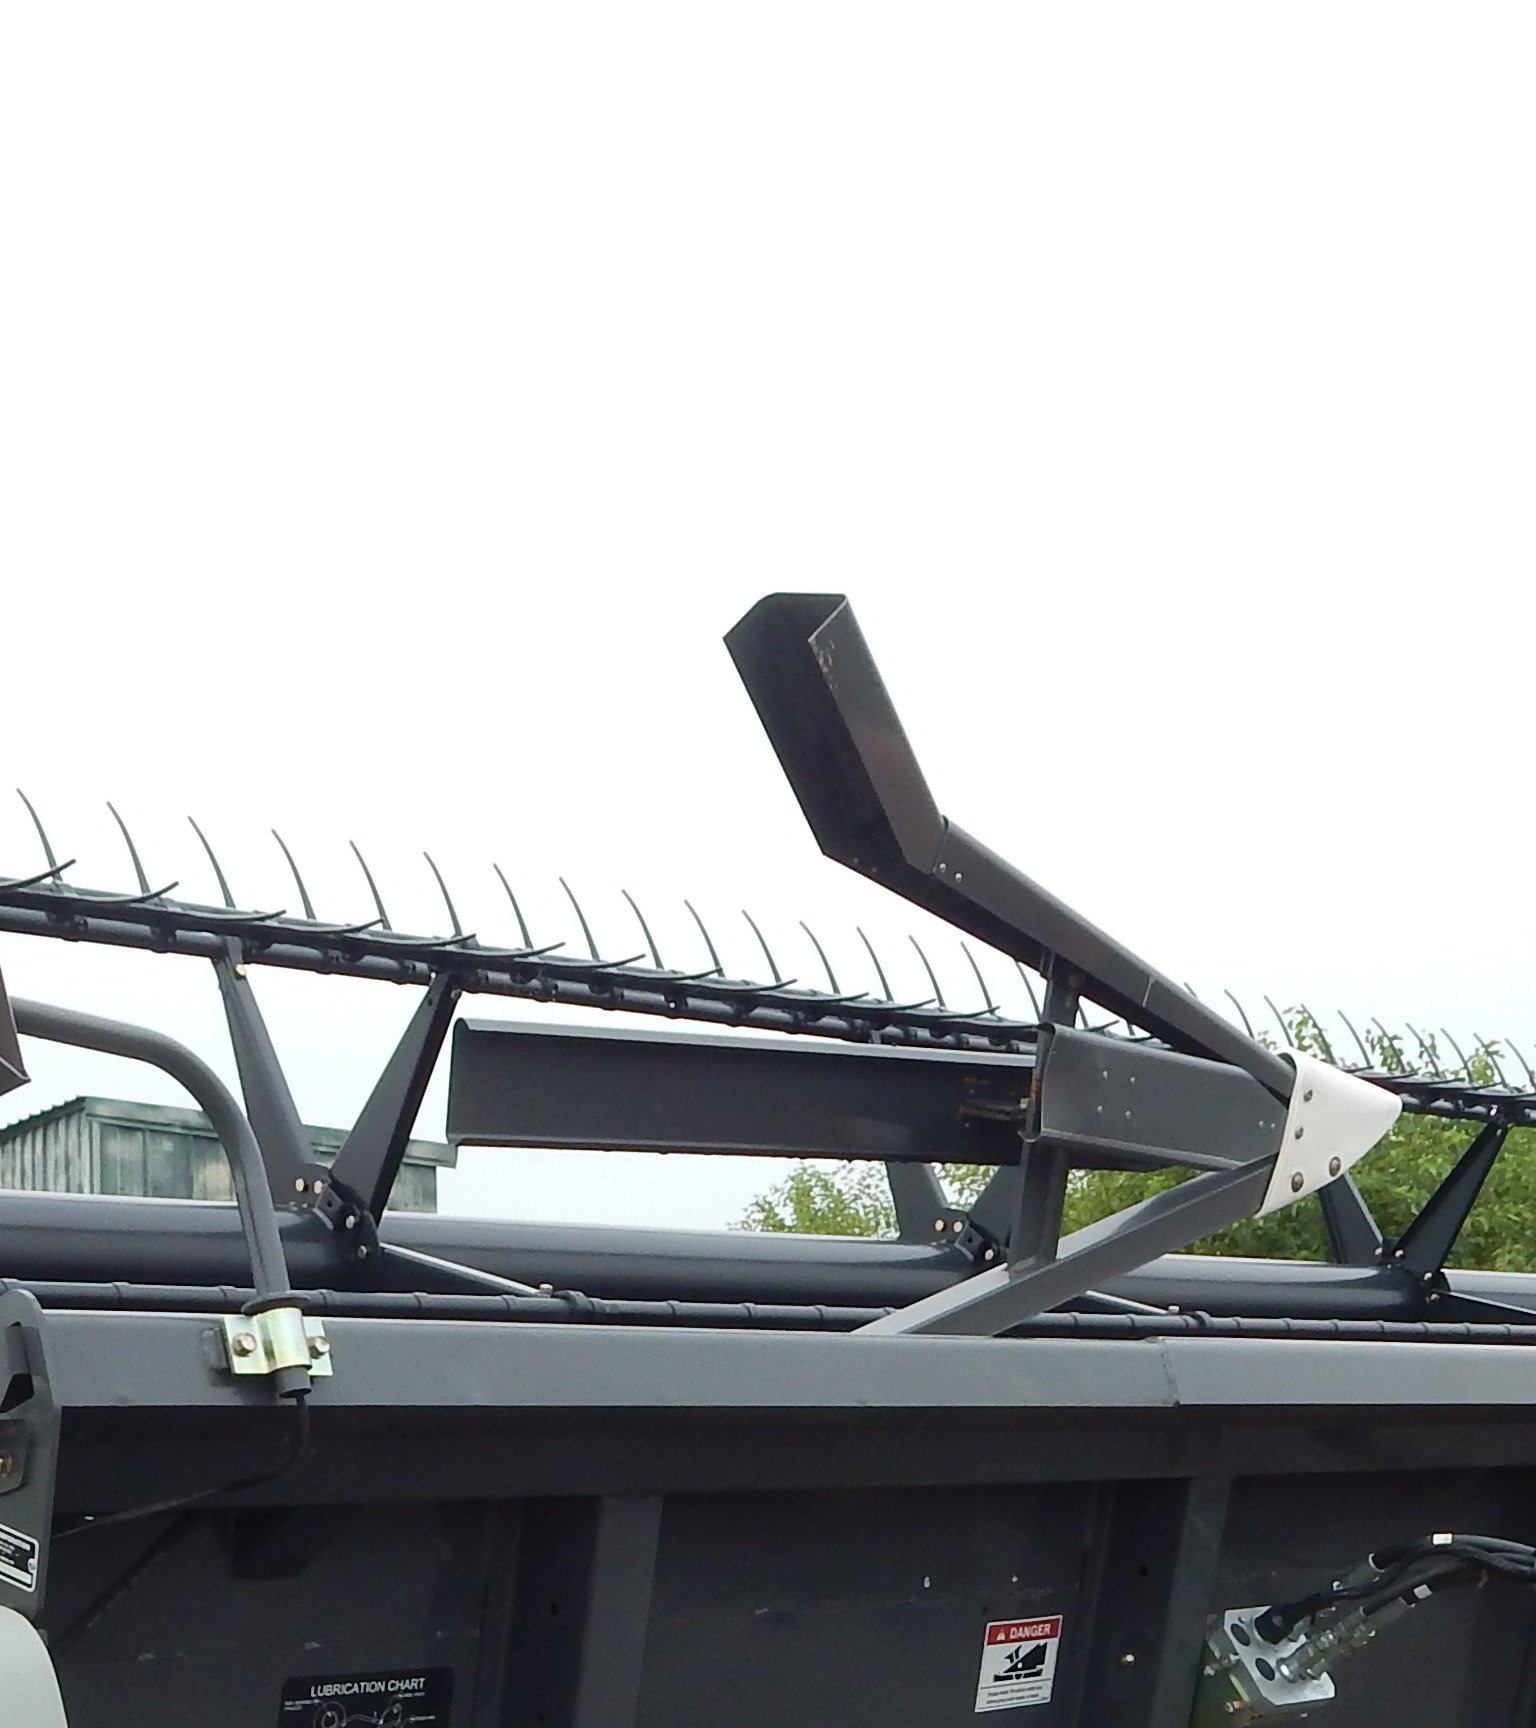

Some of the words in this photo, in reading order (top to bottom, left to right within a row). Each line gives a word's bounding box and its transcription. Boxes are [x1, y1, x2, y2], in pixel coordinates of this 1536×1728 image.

[1009, 1623, 1051, 1640] DANGER
[310, 1681, 385, 1697] LUBRICATION
[387, 1677, 425, 1691] CHART
